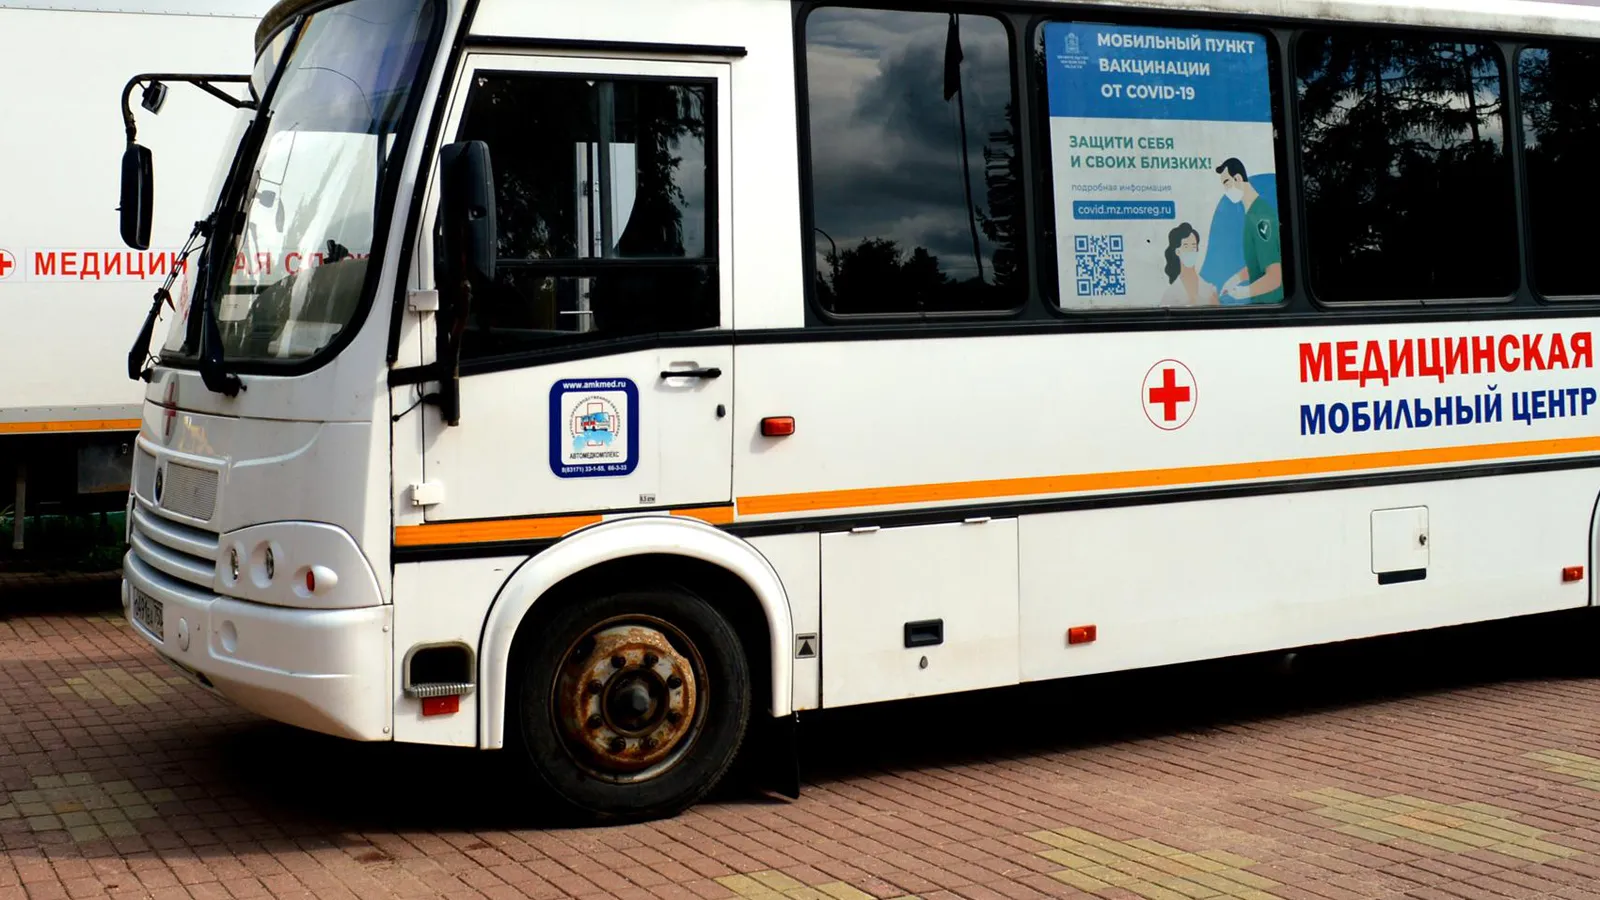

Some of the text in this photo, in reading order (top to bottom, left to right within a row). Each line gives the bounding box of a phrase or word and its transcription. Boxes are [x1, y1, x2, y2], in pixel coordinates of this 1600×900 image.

[1097, 33, 1255, 54] МОБИЛЬНЫЙ ПУНКТ
[1099, 58, 1211, 77] ВАКЦИНАЦИИ
[1101, 84, 1195, 100] ОТ COVID-19
[1069, 136, 1174, 150] ЗАЩИТИ СЕБЯ
[1070, 156, 1212, 170] И СВОИХ БЛИЗКИХ!
[1071, 183, 1172, 193] подробная информация
[1078, 205, 1172, 217] covid.mz.mosreg.ru
[1299, 331, 1593, 388] МЕДИЦИНСКАЯ
[563, 380, 626, 389] www.amkmed.ru
[1300, 384, 1597, 435] МОБИЛЬНЫЙ ЦЕНТР
[569, 451, 620, 459] АВТОМЕДКОМПЛЕКС
